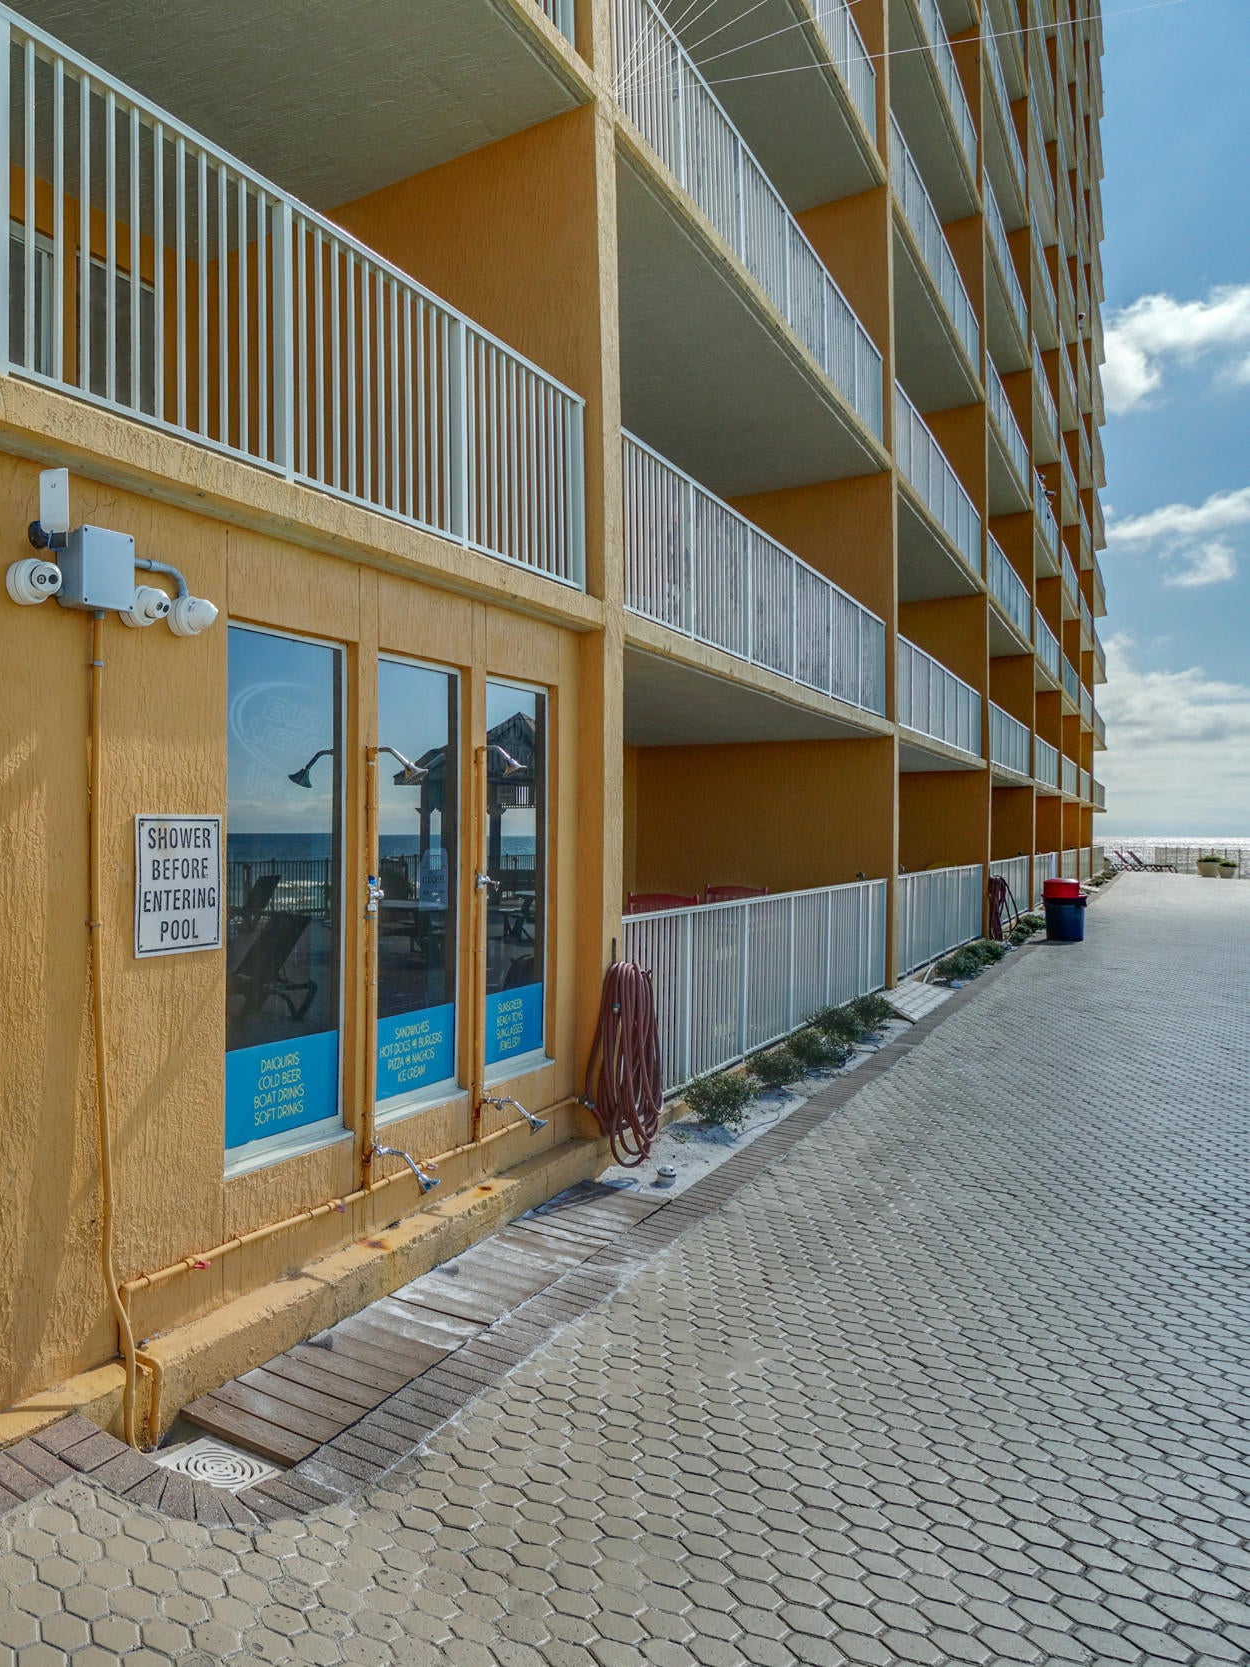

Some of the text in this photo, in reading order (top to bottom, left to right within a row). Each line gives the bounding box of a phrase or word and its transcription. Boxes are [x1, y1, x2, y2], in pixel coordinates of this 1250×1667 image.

[148, 827, 211, 849] SHOWER
[152, 857, 209, 881] BEFORE
[143, 886, 216, 913] ENTERING
[160, 918, 199, 942] POOL
[395, 1020, 430, 1040] SANDWICHES
[380, 1043, 393, 1059] HOT
[394, 1039, 411, 1055] DOGS
[419, 1031, 443, 1048] BURGERS
[261, 1051, 300, 1073] DAIQUIRIS
[388, 1057, 404, 1072] PIZZA
[412, 1047, 435, 1063] NACHOS
[258, 1068, 301, 1090] COLD BEER
[398, 1064, 426, 1083] ICE CREAM
[254, 1083, 305, 1110] BOAT DRINKS
[254, 1099, 304, 1126] SOFT DRINKS
